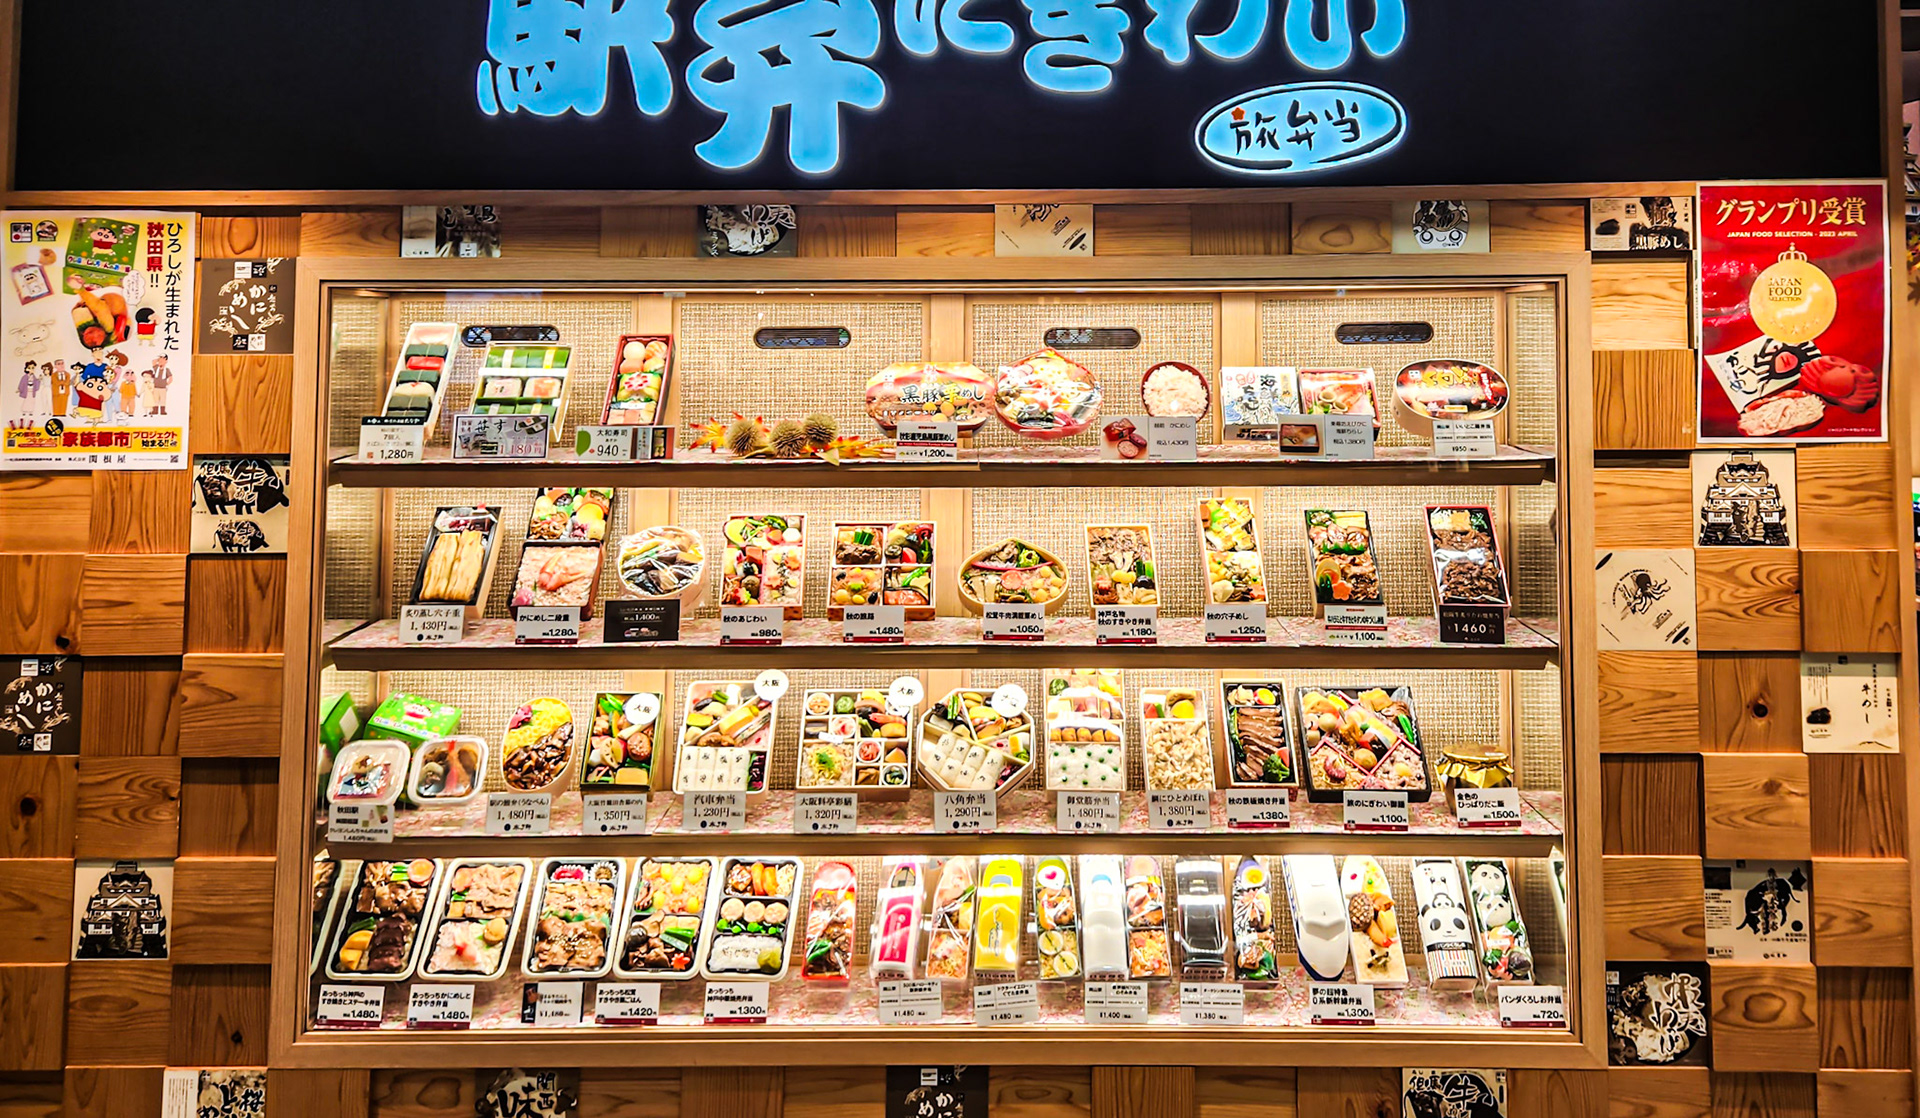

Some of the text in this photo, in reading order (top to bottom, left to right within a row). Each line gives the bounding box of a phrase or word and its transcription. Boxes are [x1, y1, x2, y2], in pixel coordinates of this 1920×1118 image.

[1230, 99, 1361, 154] 旅弁当
[1716, 197, 1867, 226] グランプリ受賞
[164, 222, 183, 350] ひろしが生まれた
[1768, 278, 1802, 286] JAPAN
[1769, 287, 1802, 296] FOOD
[133, 431, 177, 439] プロジェクト
[597, 429, 628, 437] 大和寿司
[380, 449, 414, 460] 1,280円
[597, 444, 619, 457] 940
[519, 614, 570, 622] かにめし二段重
[723, 615, 768, 623] 秋のあじわい
[1207, 612, 1249, 620] 秋の穴子めし
[761, 677, 780, 688] 大阪
[898, 686, 916, 696] 大阪
[693, 794, 735, 805] 汽車弁当
[944, 793, 986, 805] 八角弁当
[1228, 797, 1286, 805] 秋の鉄板焼き弁当
[1458, 800, 1504, 809] ひっぱりだこ飯
[593, 810, 630, 821] 1,350円
[693, 807, 730, 817] 1,230円
[804, 809, 841, 819] 1,320円
[945, 807, 981, 818] 1,290円
[1159, 805, 1195, 816] 1,380円
[322, 990, 365, 998] あっちっち神戸の
[1312, 988, 1348, 996] 夢の超特急
[411, 1000, 448, 1008] すきやき弁当
[1501, 995, 1562, 1004] パンダくろしお弁当
